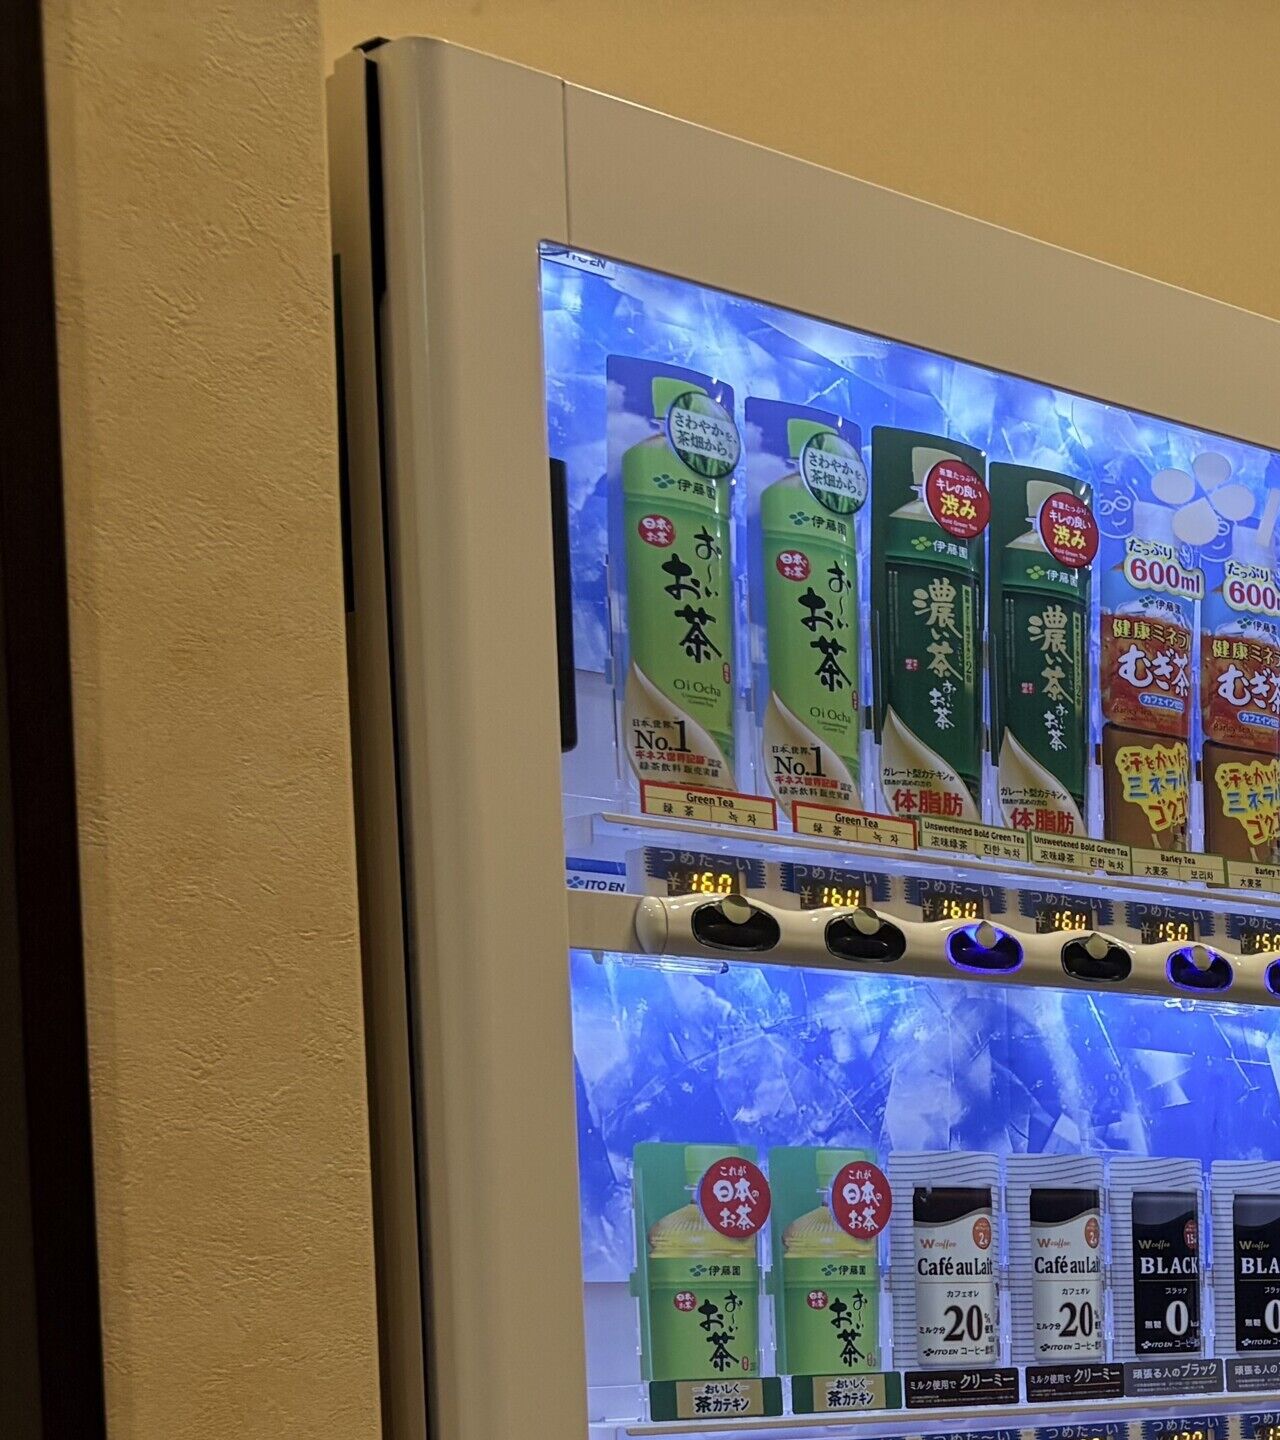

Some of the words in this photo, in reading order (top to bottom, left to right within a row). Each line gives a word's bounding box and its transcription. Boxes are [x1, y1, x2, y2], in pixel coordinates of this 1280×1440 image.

[941, 492, 977, 520] 渋み
[1053, 524, 1087, 550] 渋み
[1128, 538, 1175, 559] たっぷり
[1130, 557, 1201, 594] 600ml
[1227, 561, 1272, 581] たっぷり
[634, 721, 691, 752] No.1
[774, 746, 826, 776] No.1
[687, 792, 715, 806] Green
[717, 797, 734, 808] Tea
[892, 789, 964, 818] 体脂肪
[835, 813, 861, 826] Green
[863, 817, 878, 828] Tea
[1010, 808, 1074, 834] 体脂肪
[924, 821, 971, 836] Unsweetened
[974, 828, 989, 839] Bold
[991, 831, 1009, 843] Green
[1012, 834, 1025, 844] Tea
[1161, 854, 1179, 866] Barley
[1181, 855, 1196, 864] Tea
[719, 1166, 747, 1177] これが
[849, 1169, 872, 1180] これが
[713, 1179, 760, 1205] 日本の
[842, 1181, 882, 1207] 日本の
[719, 1204, 755, 1231] お茶
[849, 1207, 879, 1231] お茶
[917, 1257, 953, 1276] Café
[956, 1261, 972, 1275] au
[974, 1258, 993, 1275] Lait
[1034, 1256, 1067, 1274] Café
[1070, 1260, 1085, 1273] au
[1141, 1257, 1198, 1274] BLACK
[944, 1304, 984, 1342] 20
[1059, 1302, 1093, 1337] 20
[1165, 1301, 1189, 1336] 0
[837, 1379, 866, 1390] おいしく
[960, 1373, 1015, 1389] クリーミー
[1074, 1368, 1120, 1383] クリーミー
[704, 1384, 739, 1395] おいしく
[828, 1391, 873, 1407] 茶カテキン
[694, 1395, 749, 1412] 茶カテキン
